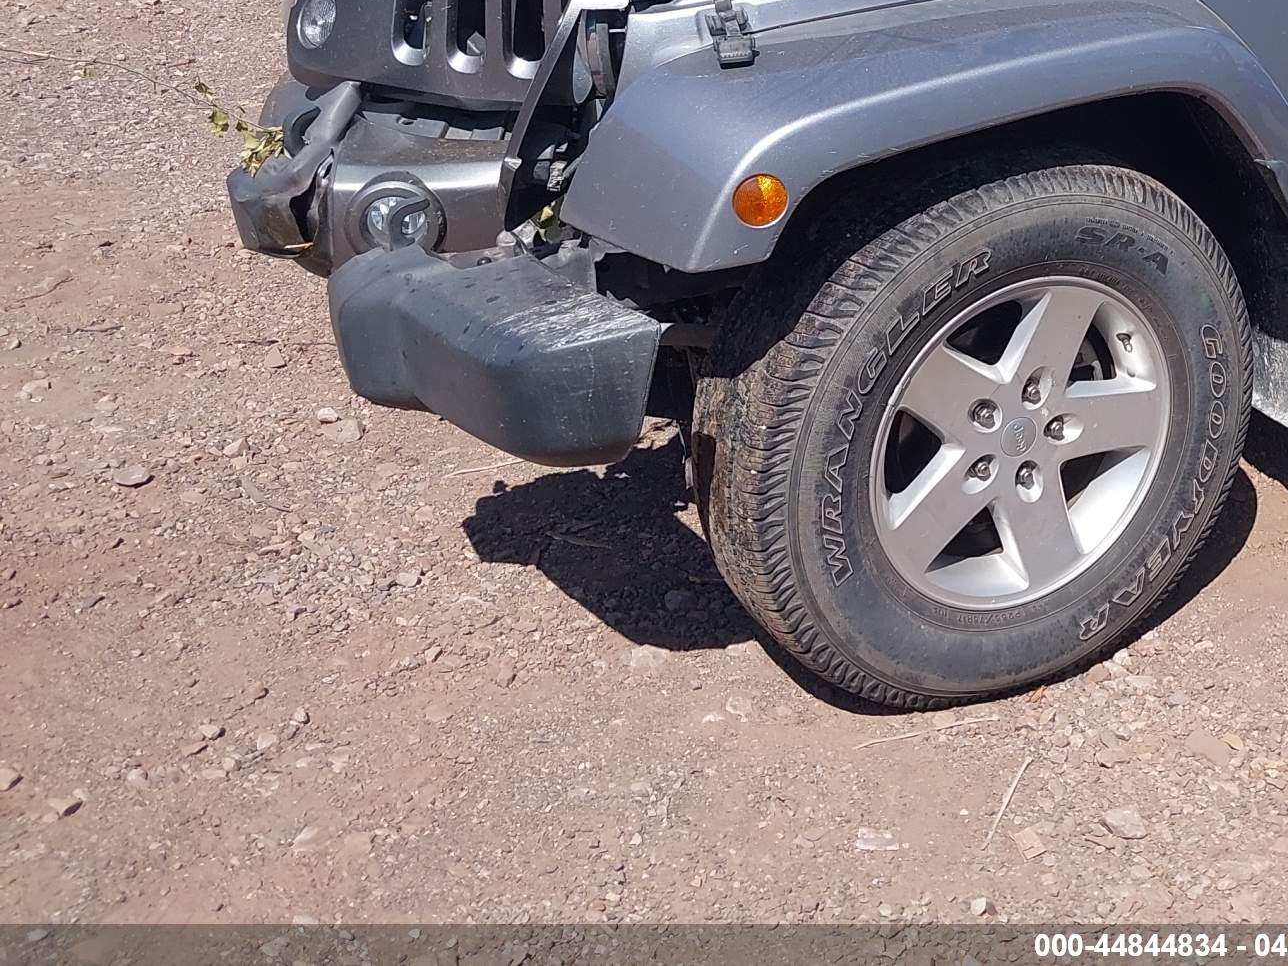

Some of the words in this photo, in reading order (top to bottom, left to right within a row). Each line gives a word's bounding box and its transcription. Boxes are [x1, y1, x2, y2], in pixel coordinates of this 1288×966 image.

[818, 248, 992, 588] WRANGLER
[1013, 425, 1026, 452] Jeep
[1080, 324, 1227, 641] GOODYEAR
